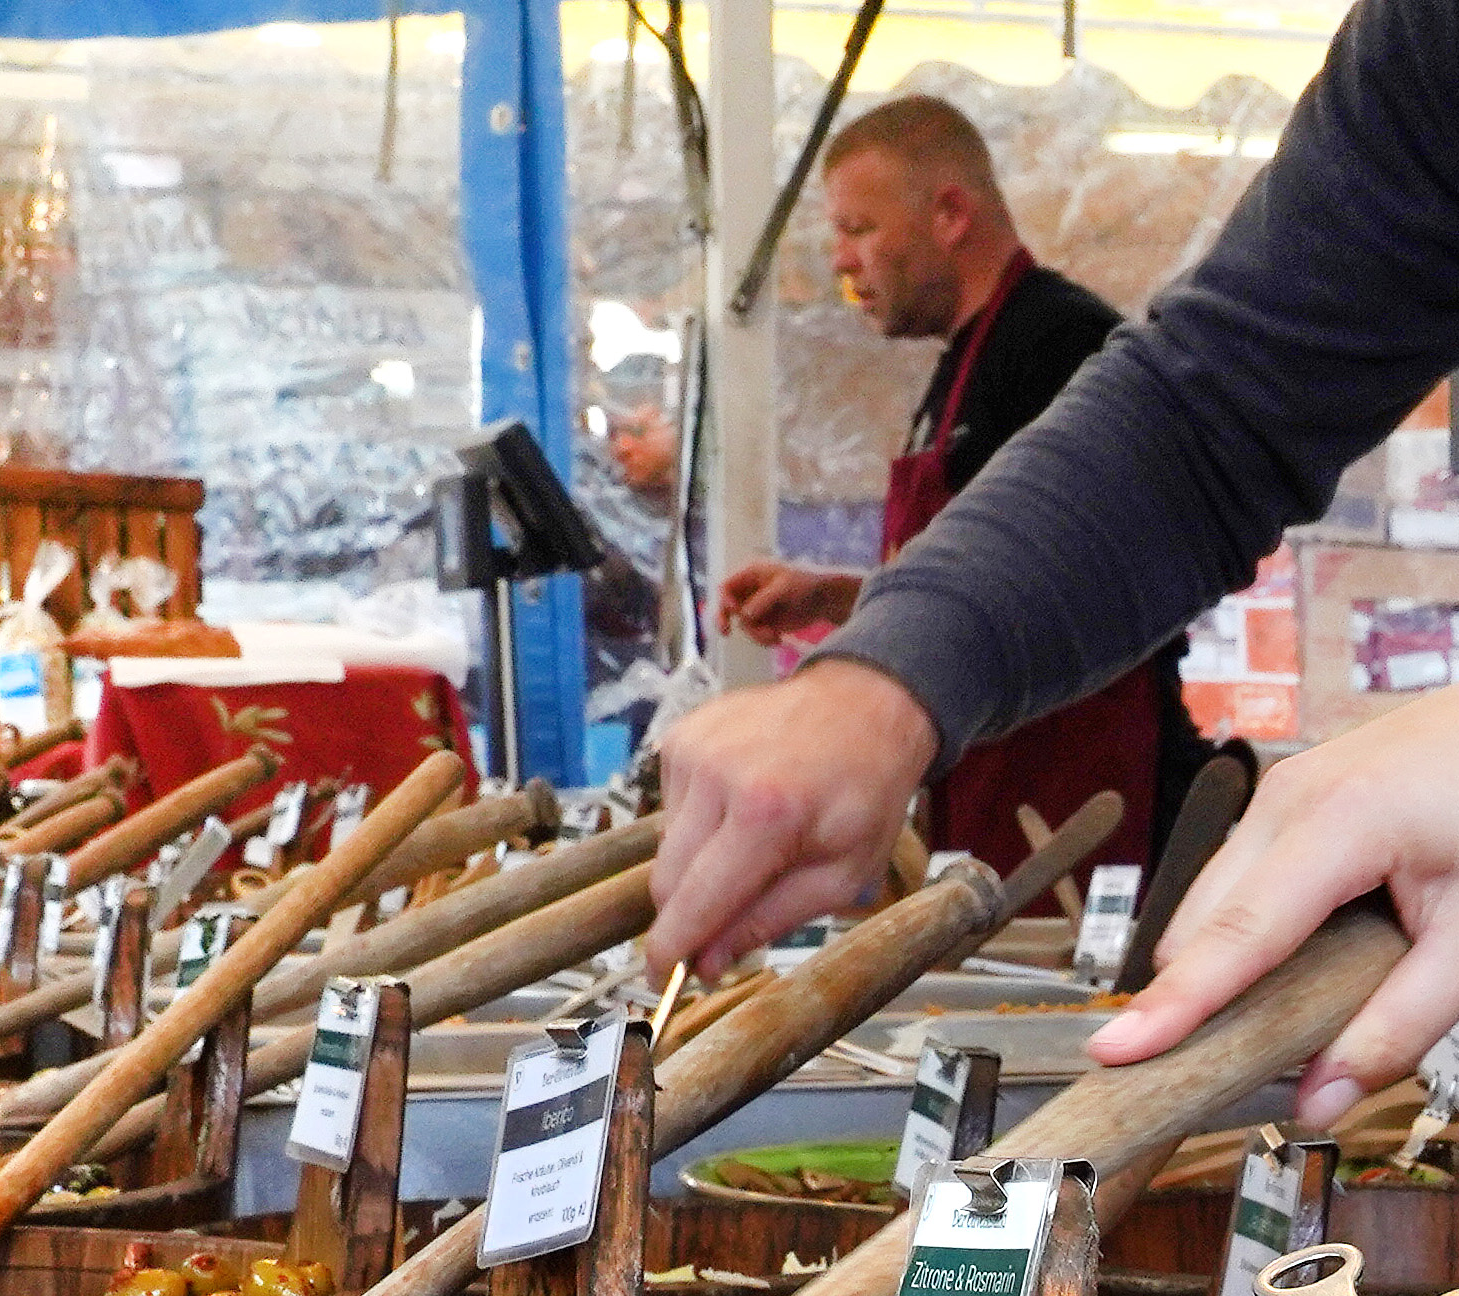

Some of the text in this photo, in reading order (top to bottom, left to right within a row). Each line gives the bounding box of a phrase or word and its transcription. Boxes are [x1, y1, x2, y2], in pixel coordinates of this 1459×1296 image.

[910, 1260, 1017, 1295] Zitrone & Rosmarin
